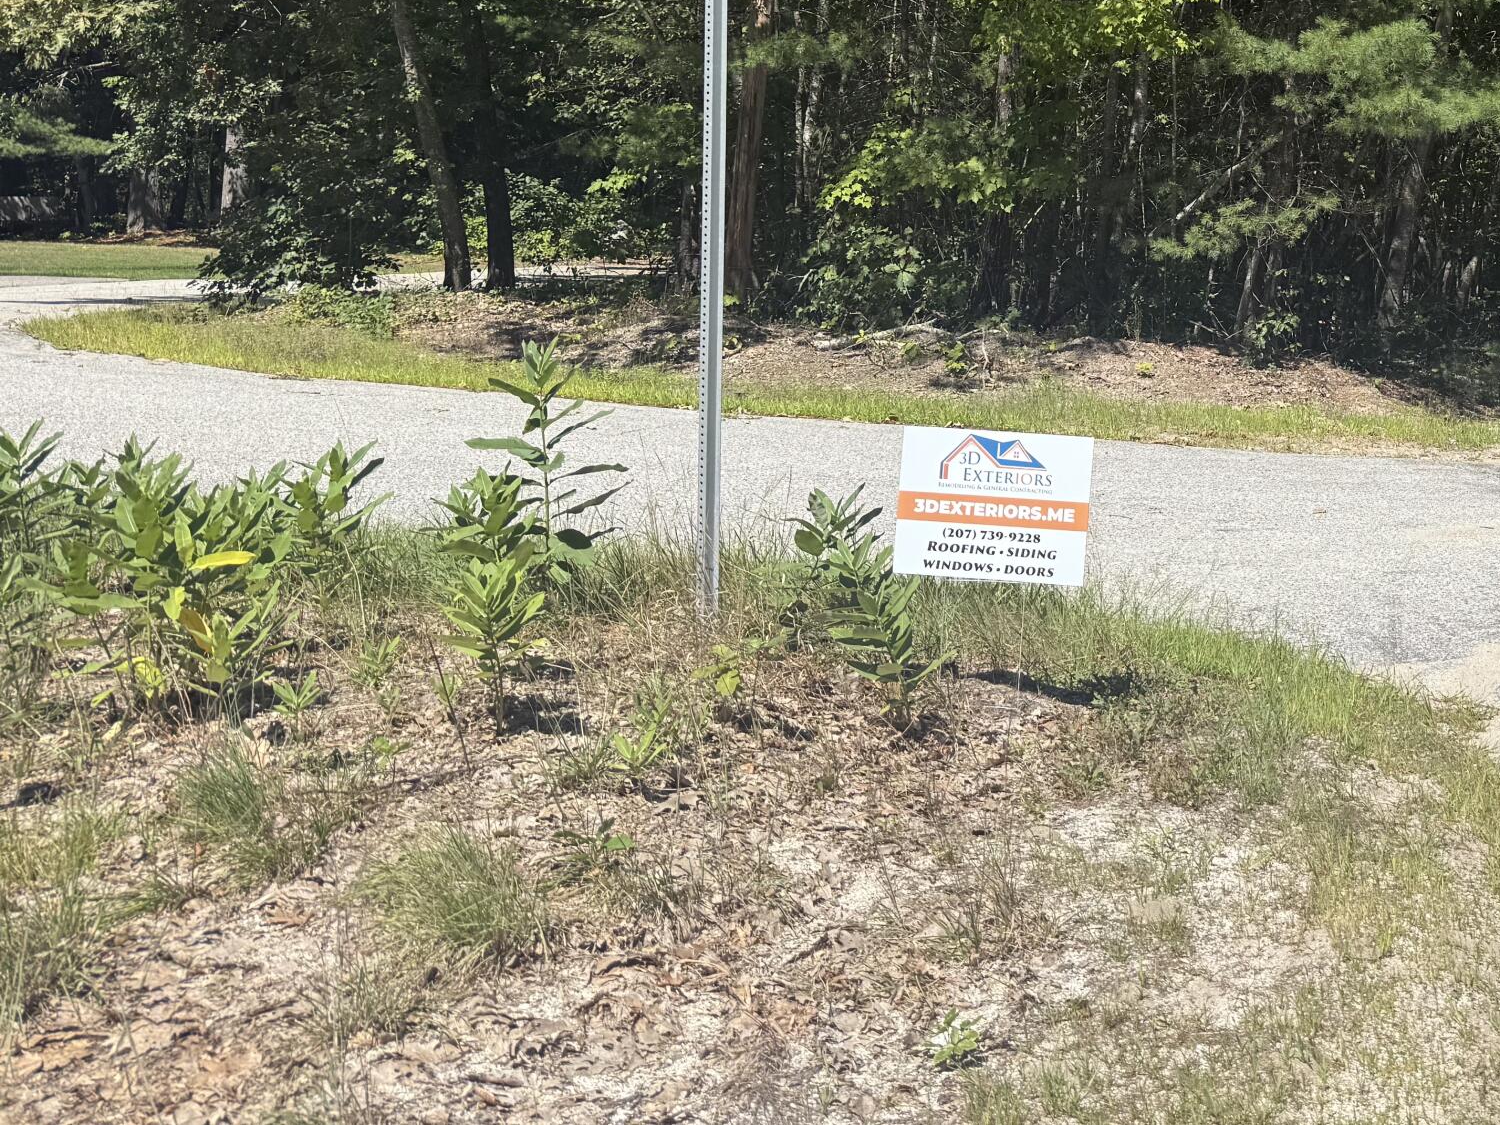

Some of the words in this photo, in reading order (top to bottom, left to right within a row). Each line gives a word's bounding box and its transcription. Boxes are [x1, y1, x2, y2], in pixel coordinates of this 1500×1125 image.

[959, 451, 981, 465] 3D
[963, 467, 1053, 487] EXTERIORS
[914, 498, 1075, 523] 3DEXTERIORS.ME
[942, 527, 977, 541] (207)
[981, 530, 1041, 544] 739-9228
[927, 540, 996, 556] ROOFING
[1006, 547, 1057, 561] SIDING
[923, 559, 994, 574] WINDOWS
[1004, 565, 1055, 578] DOORS
